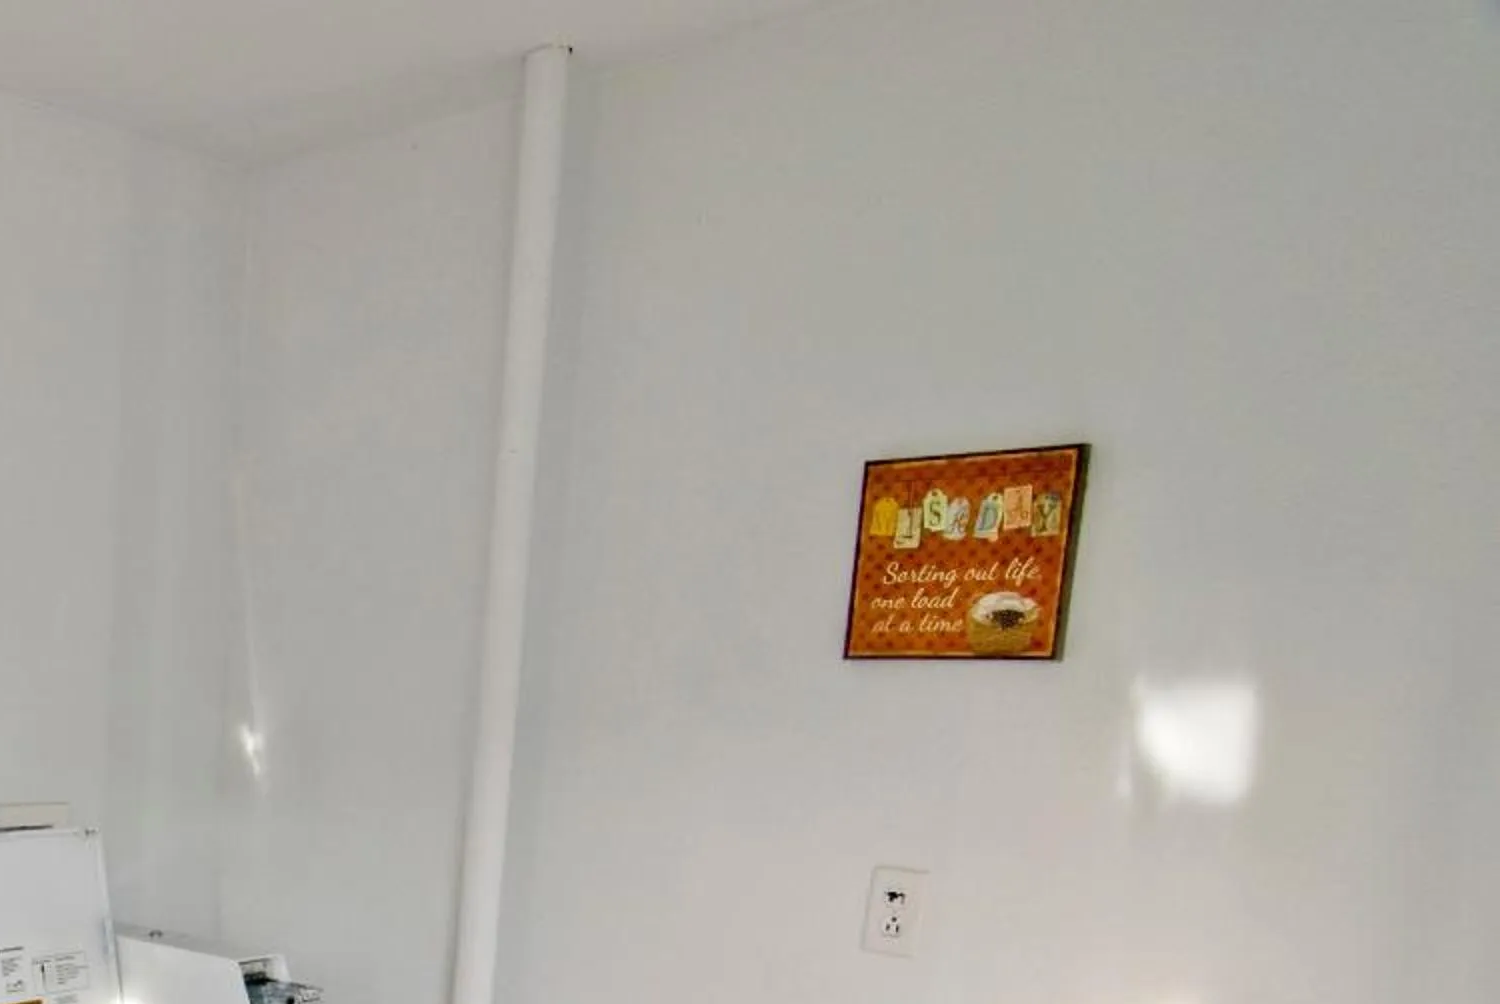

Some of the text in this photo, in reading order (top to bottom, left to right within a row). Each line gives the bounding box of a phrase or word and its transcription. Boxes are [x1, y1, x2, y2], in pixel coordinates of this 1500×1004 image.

[883, 556, 1041, 588] Sorting out life
[871, 587, 959, 609] one load
[872, 614, 963, 633] at a time
